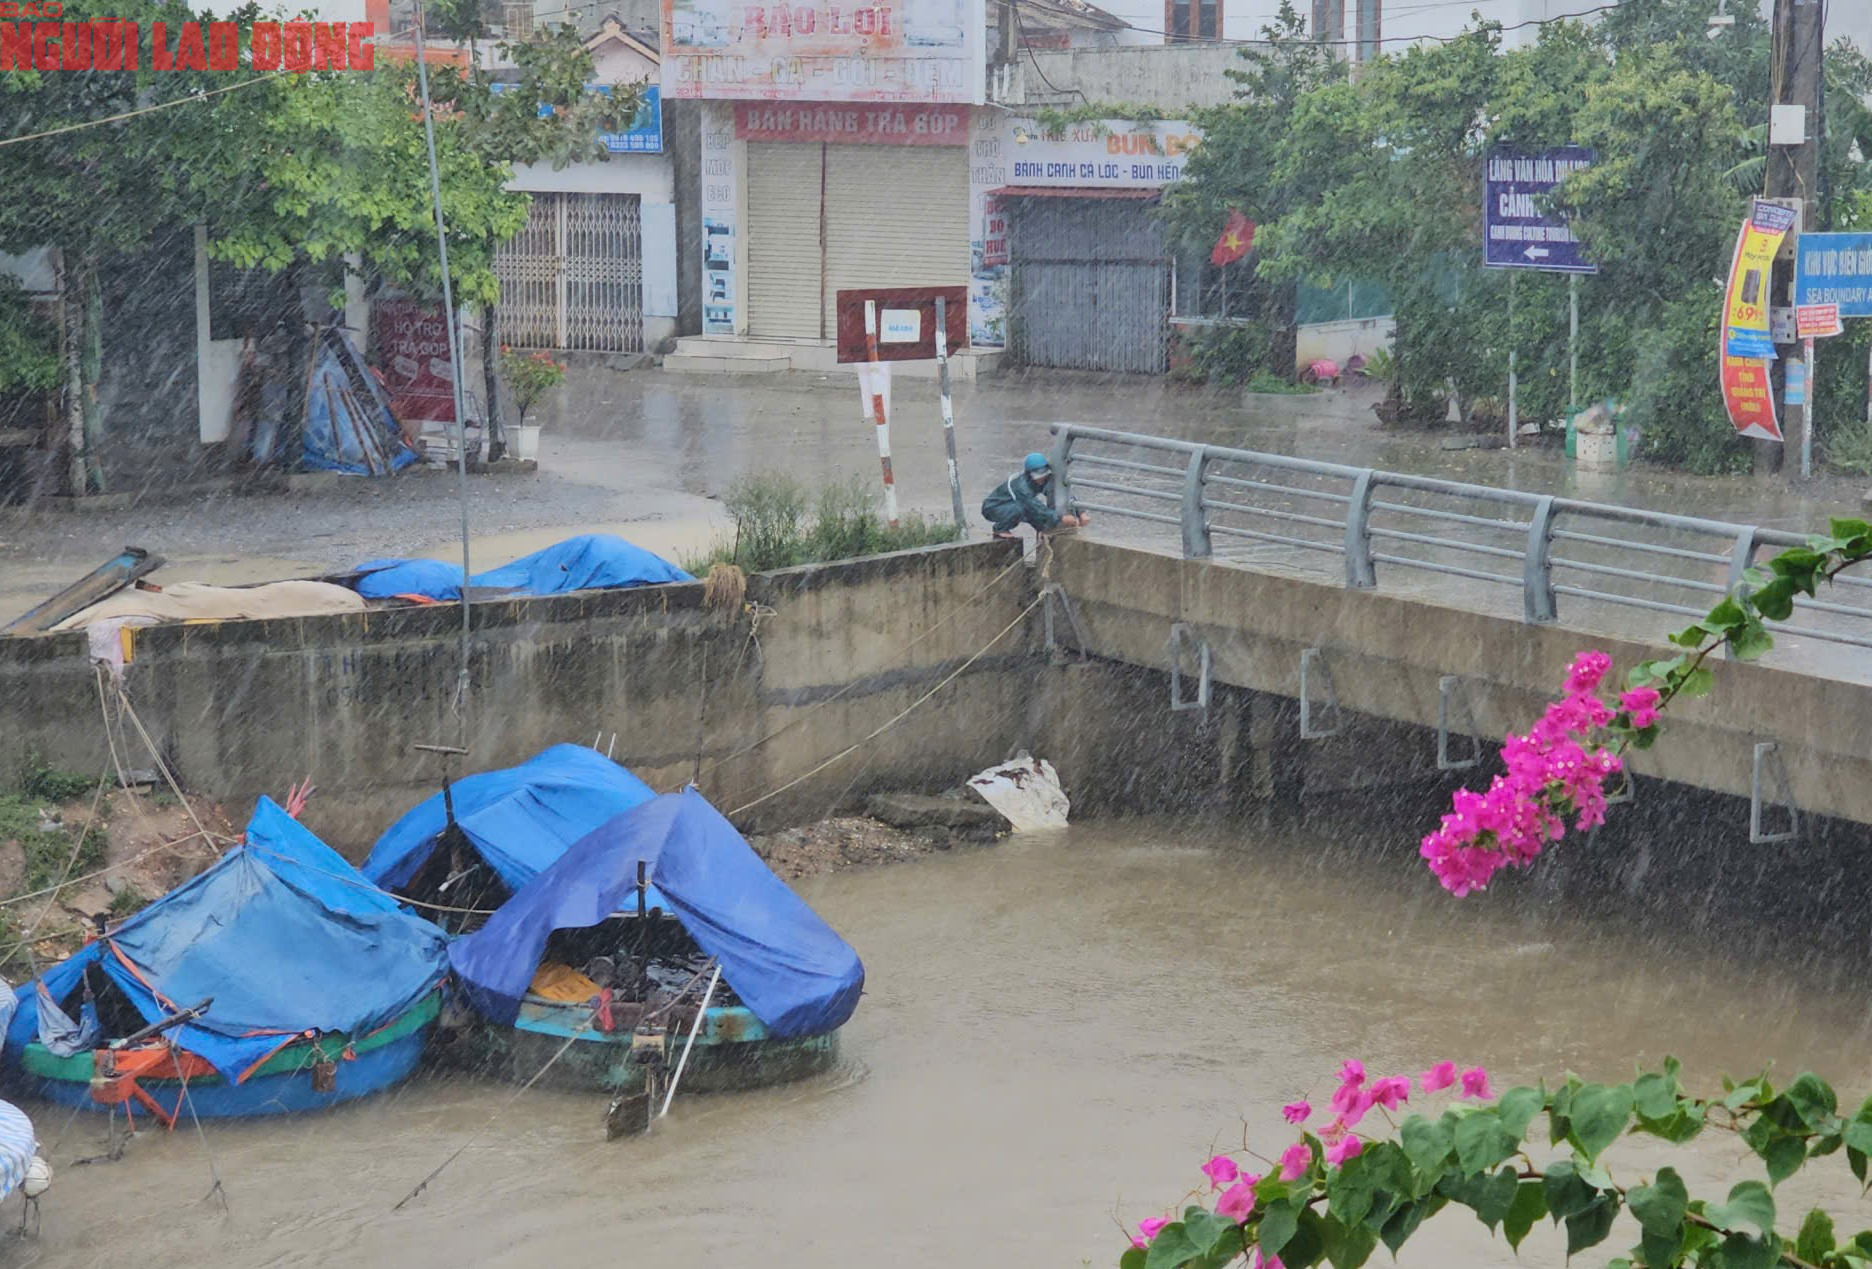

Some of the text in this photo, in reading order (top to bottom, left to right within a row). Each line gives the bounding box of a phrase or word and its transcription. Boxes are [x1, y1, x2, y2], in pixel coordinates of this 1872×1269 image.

[770, 55, 805, 85] GA
[1047, 163, 1076, 178] CANH
[1080, 160, 1094, 178] CÁ
[1489, 155, 1513, 182] LÀNG
[1514, 156, 1533, 182] VĂN
[1535, 155, 1554, 183] HÓA
[1500, 186, 1534, 218] CẢNH
[1805, 250, 1821, 276] KHU
[1806, 287, 1822, 303] SEA
[1824, 287, 1866, 304] BOUNDARY
